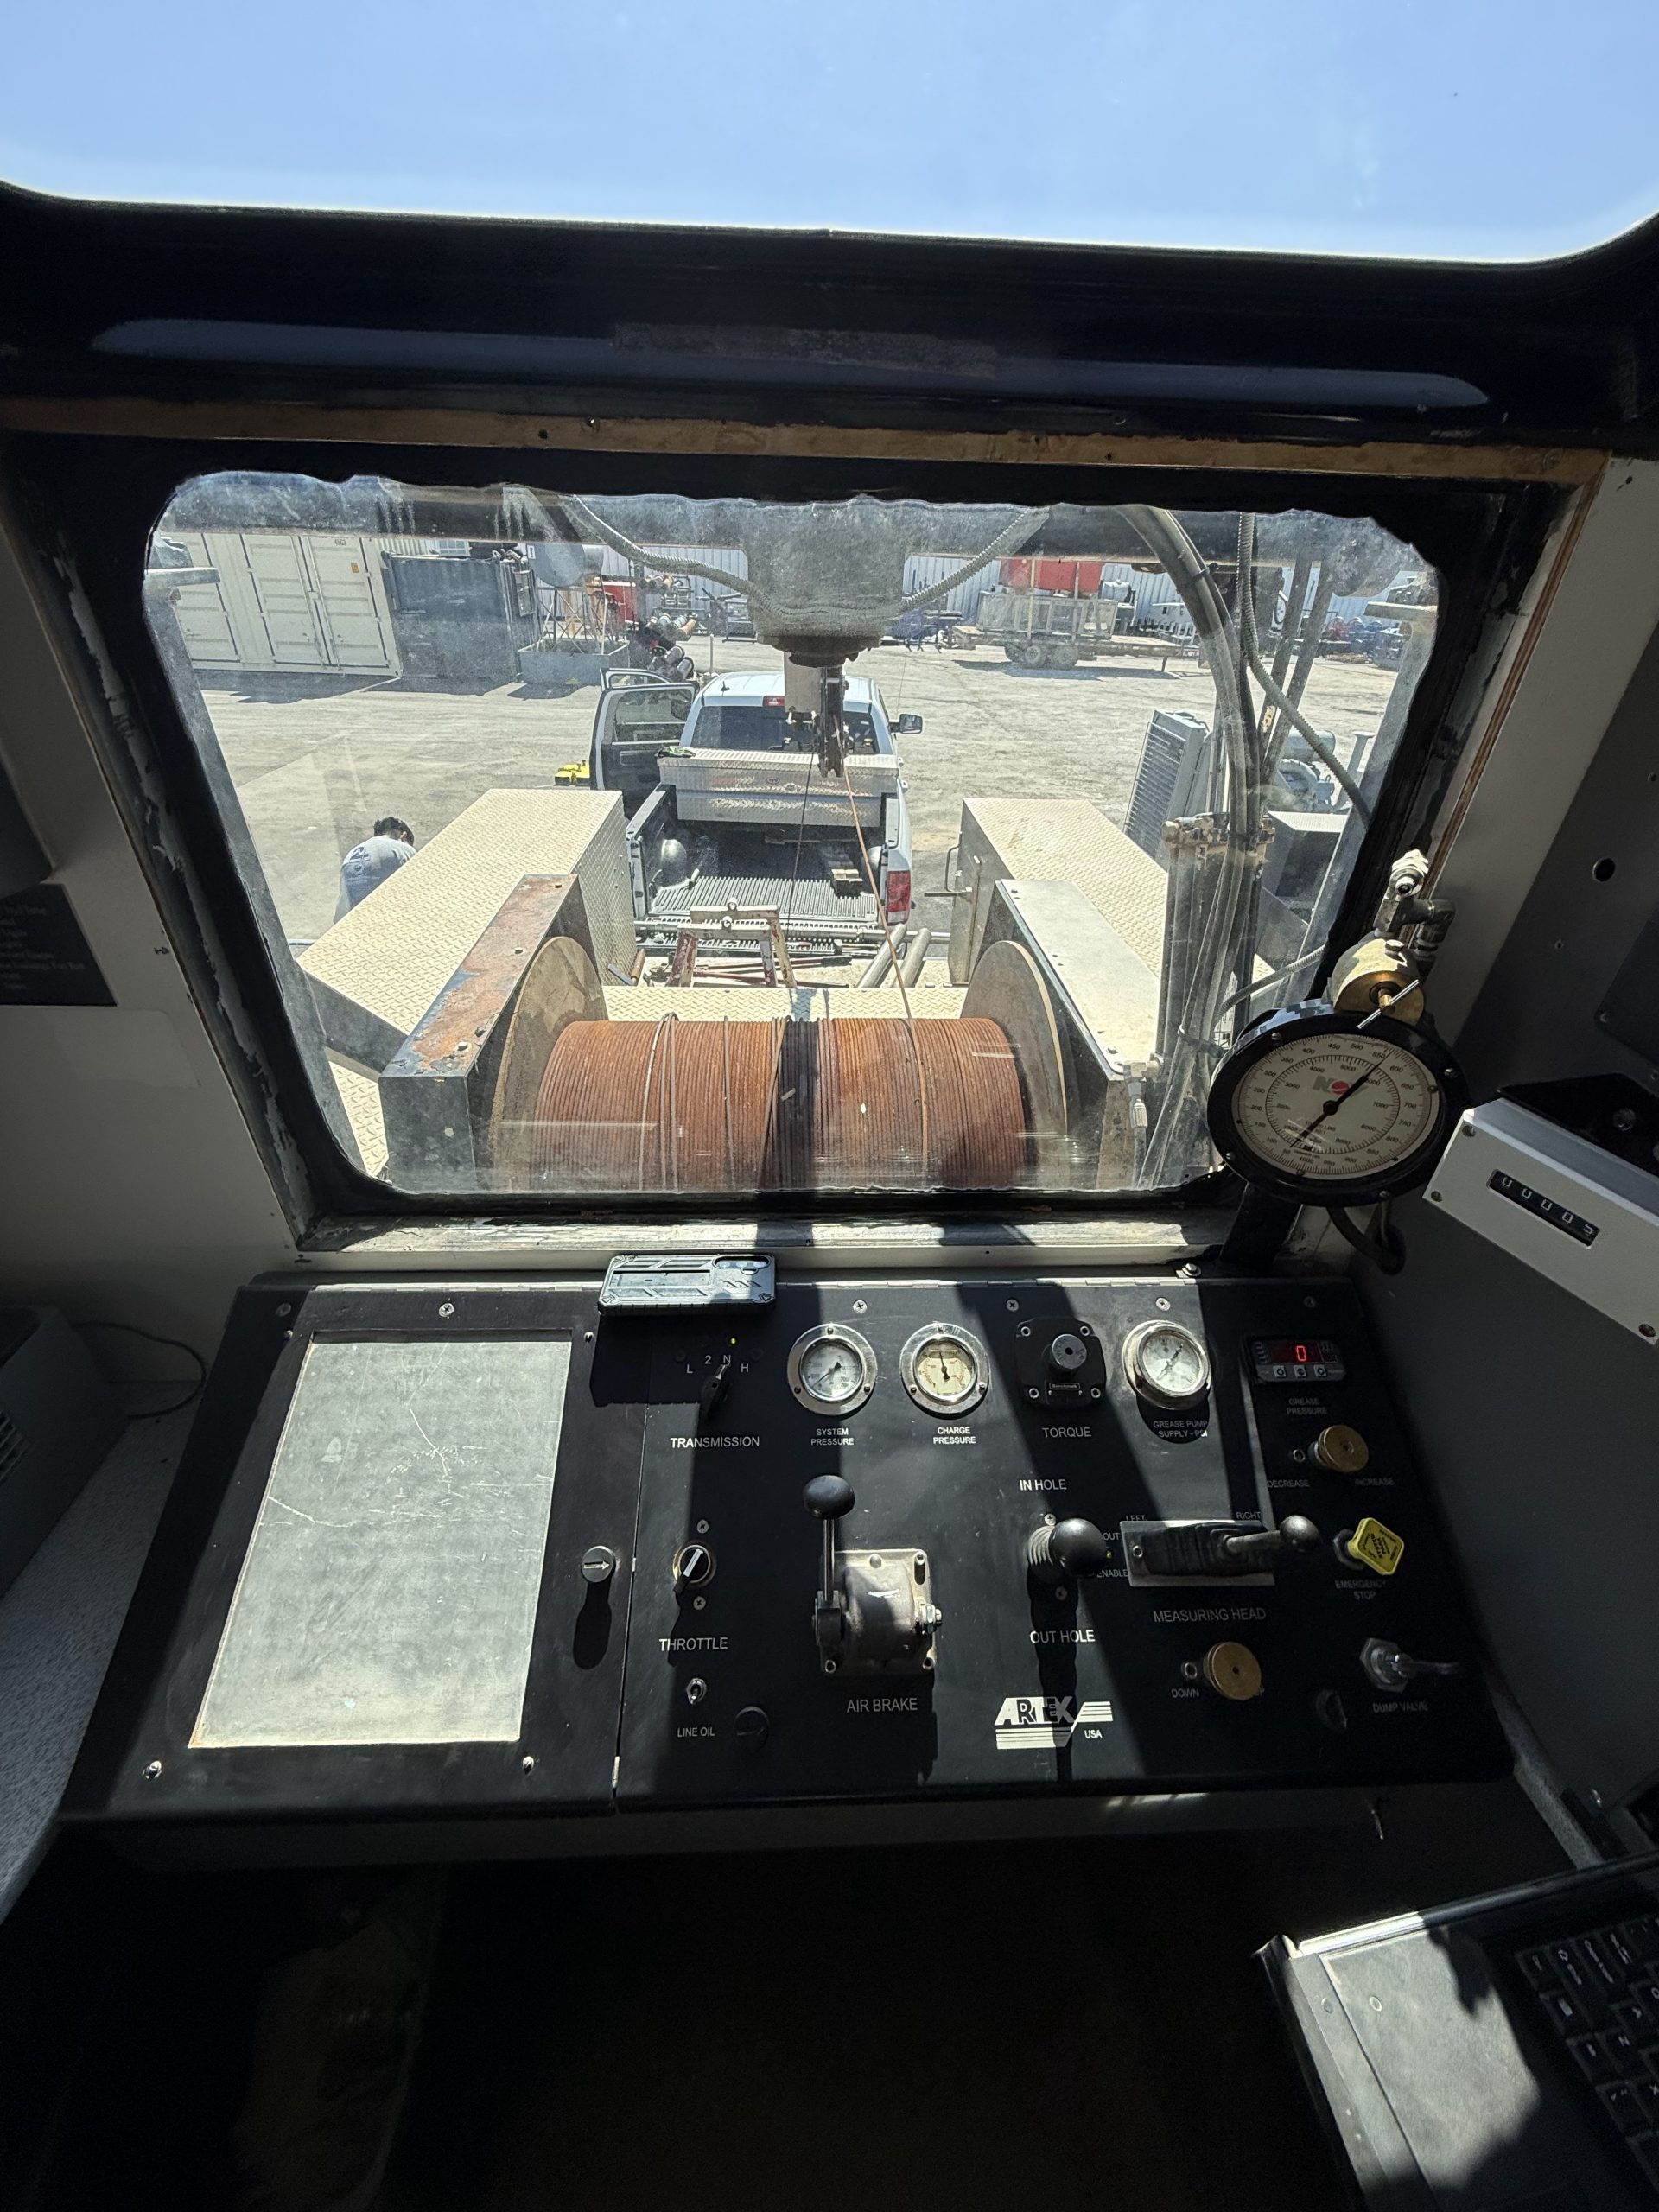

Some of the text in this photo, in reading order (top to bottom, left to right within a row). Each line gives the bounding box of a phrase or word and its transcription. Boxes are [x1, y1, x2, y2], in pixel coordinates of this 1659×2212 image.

[704, 1355, 711, 1365] 2
[722, 1354, 731, 1364] N
[686, 1363, 693, 1374] L
[741, 1363, 749, 1373] H
[1286, 1407, 1327, 1416] PRESSURE
[1186, 1420, 1208, 1428] PUMP
[816, 1427, 849, 1436] SYSTEM
[938, 1427, 971, 1435] CHARGE
[1041, 1427, 1092, 1438] TORQUE
[670, 1436, 760, 1449] TRANSMISSION
[810, 1437, 855, 1446] PRESSURE
[932, 1436, 976, 1445] PRESSURE
[1019, 1478, 1068, 1491] IN HOLE
[1267, 1479, 1311, 1489] DECREASE
[1236, 1511, 1262, 1520] RIGHT
[1103, 1531, 1120, 1541] OUT
[1335, 1580, 1388, 1590] EMERGENCY
[1353, 1590, 1376, 1601] STOP
[1153, 1607, 1267, 1623] MEASURING HEAD
[1030, 1629, 1096, 1644] OUT HOLE
[658, 1637, 729, 1652] THROTTLE
[1171, 1688, 1200, 1699] DOWN
[846, 1697, 919, 1713] AIR BRAKE
[1372, 1701, 1398, 1714] DUMP
[994, 1696, 1077, 1726] ARTEK
[677, 1726, 716, 1738] LINE OIL
[1084, 1729, 1103, 1739] USA
